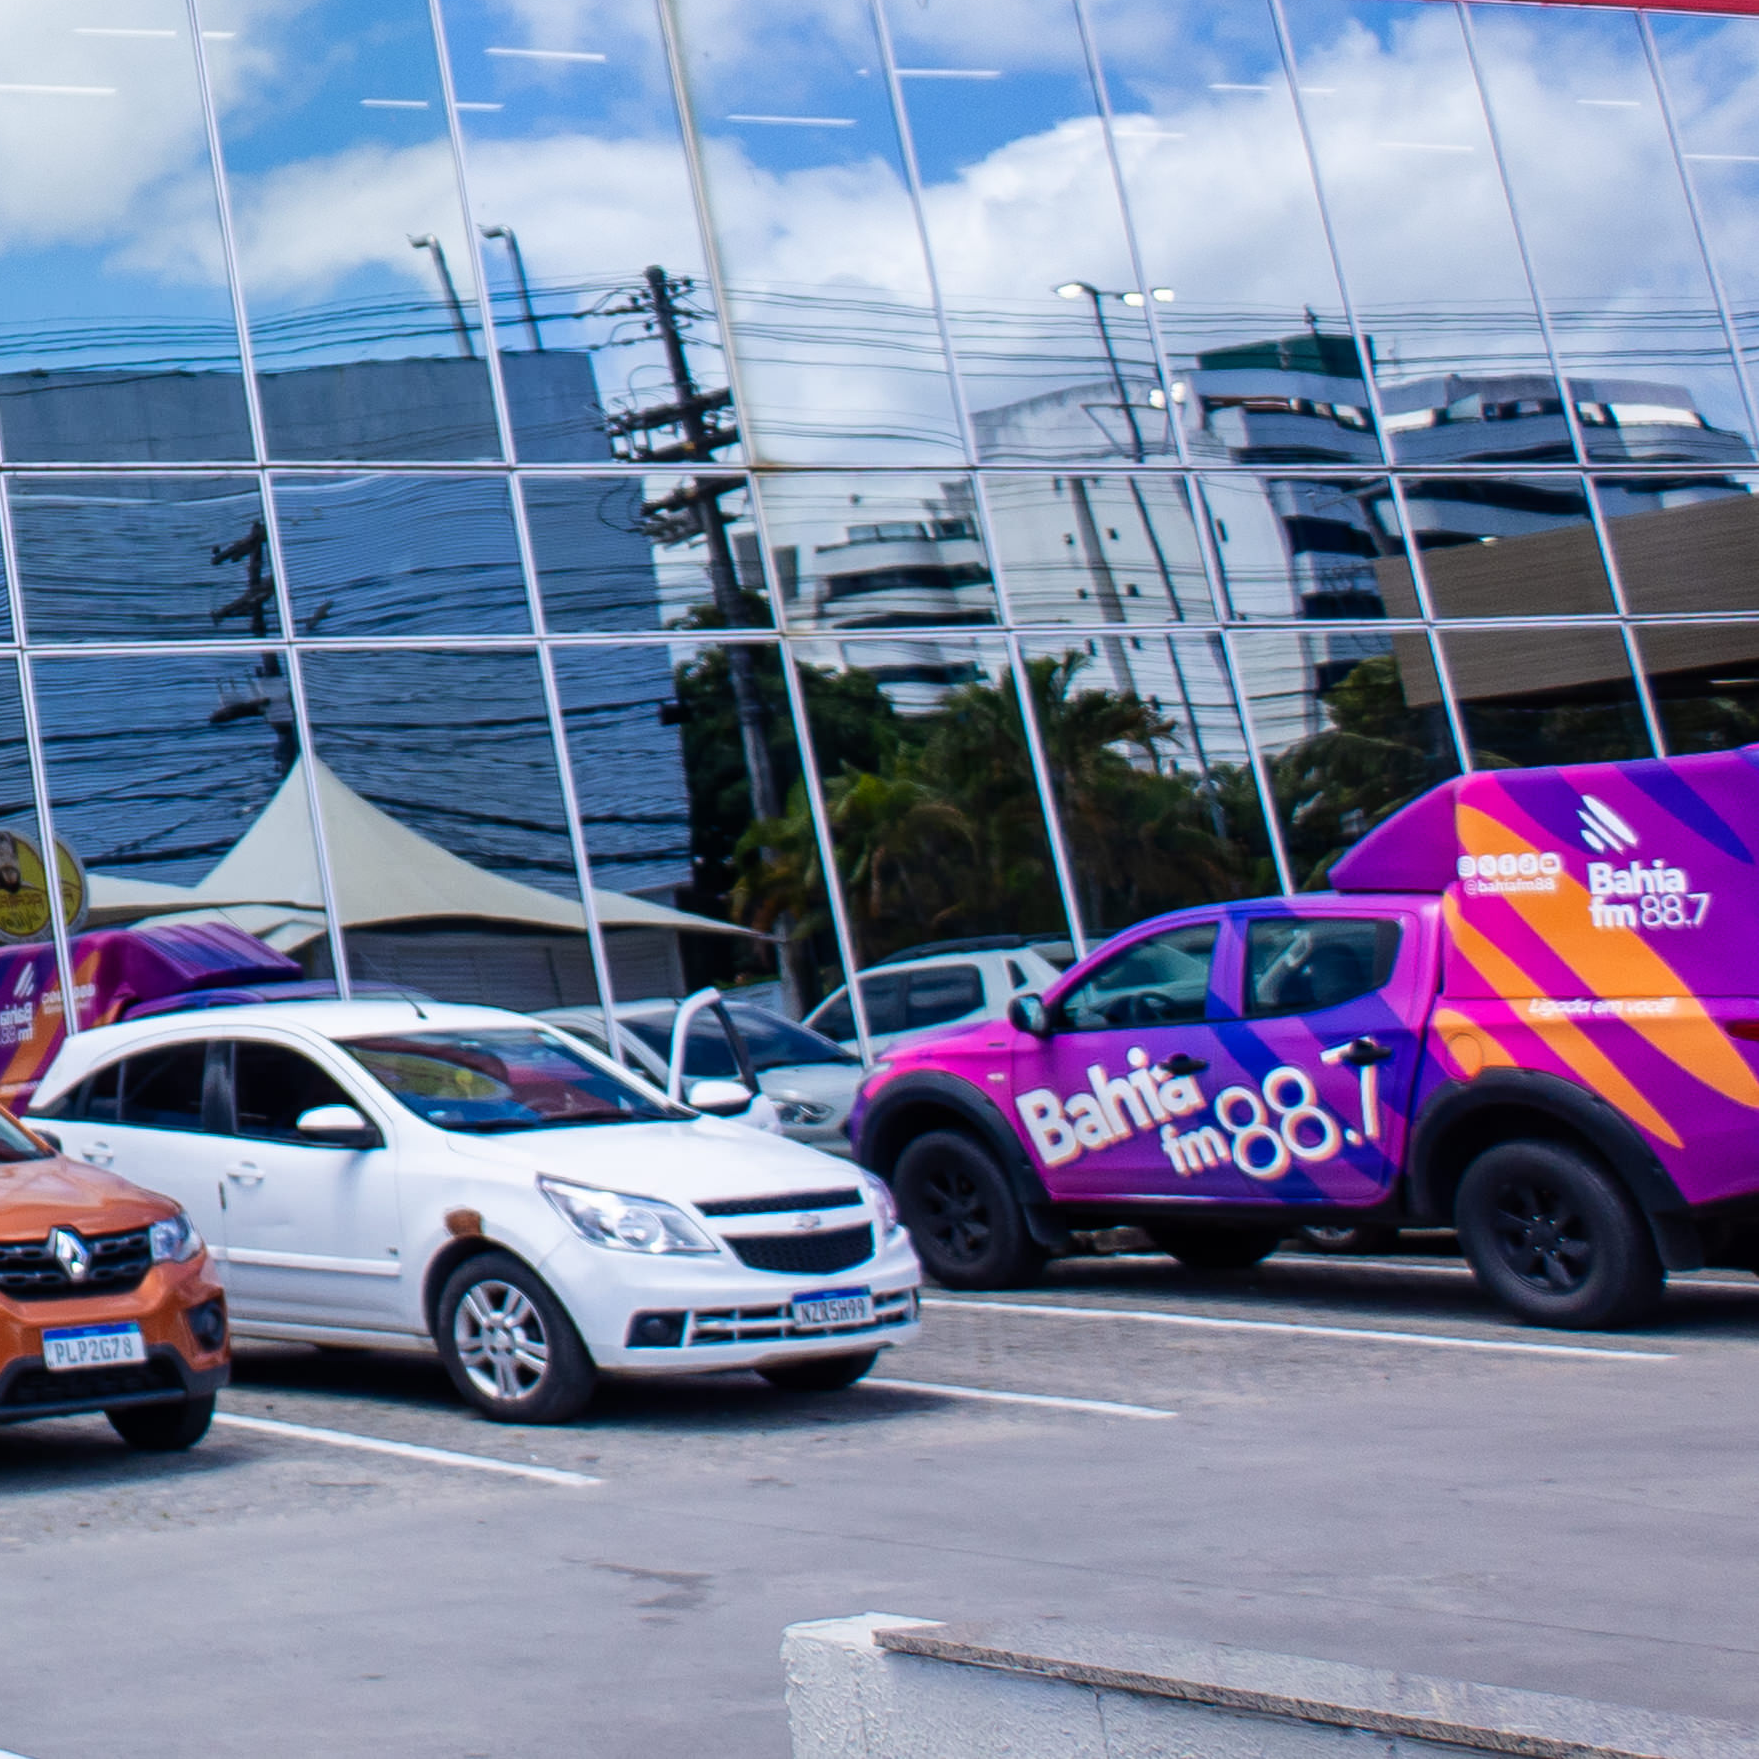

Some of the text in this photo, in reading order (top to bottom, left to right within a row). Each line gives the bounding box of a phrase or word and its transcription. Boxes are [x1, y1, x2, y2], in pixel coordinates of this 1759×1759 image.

[1587, 858, 1687, 895] Bahia
[1588, 893, 1710, 928] fm 88.7
[1015, 1047, 1207, 1167] Bahia
[1161, 1121, 1230, 1176] fm
